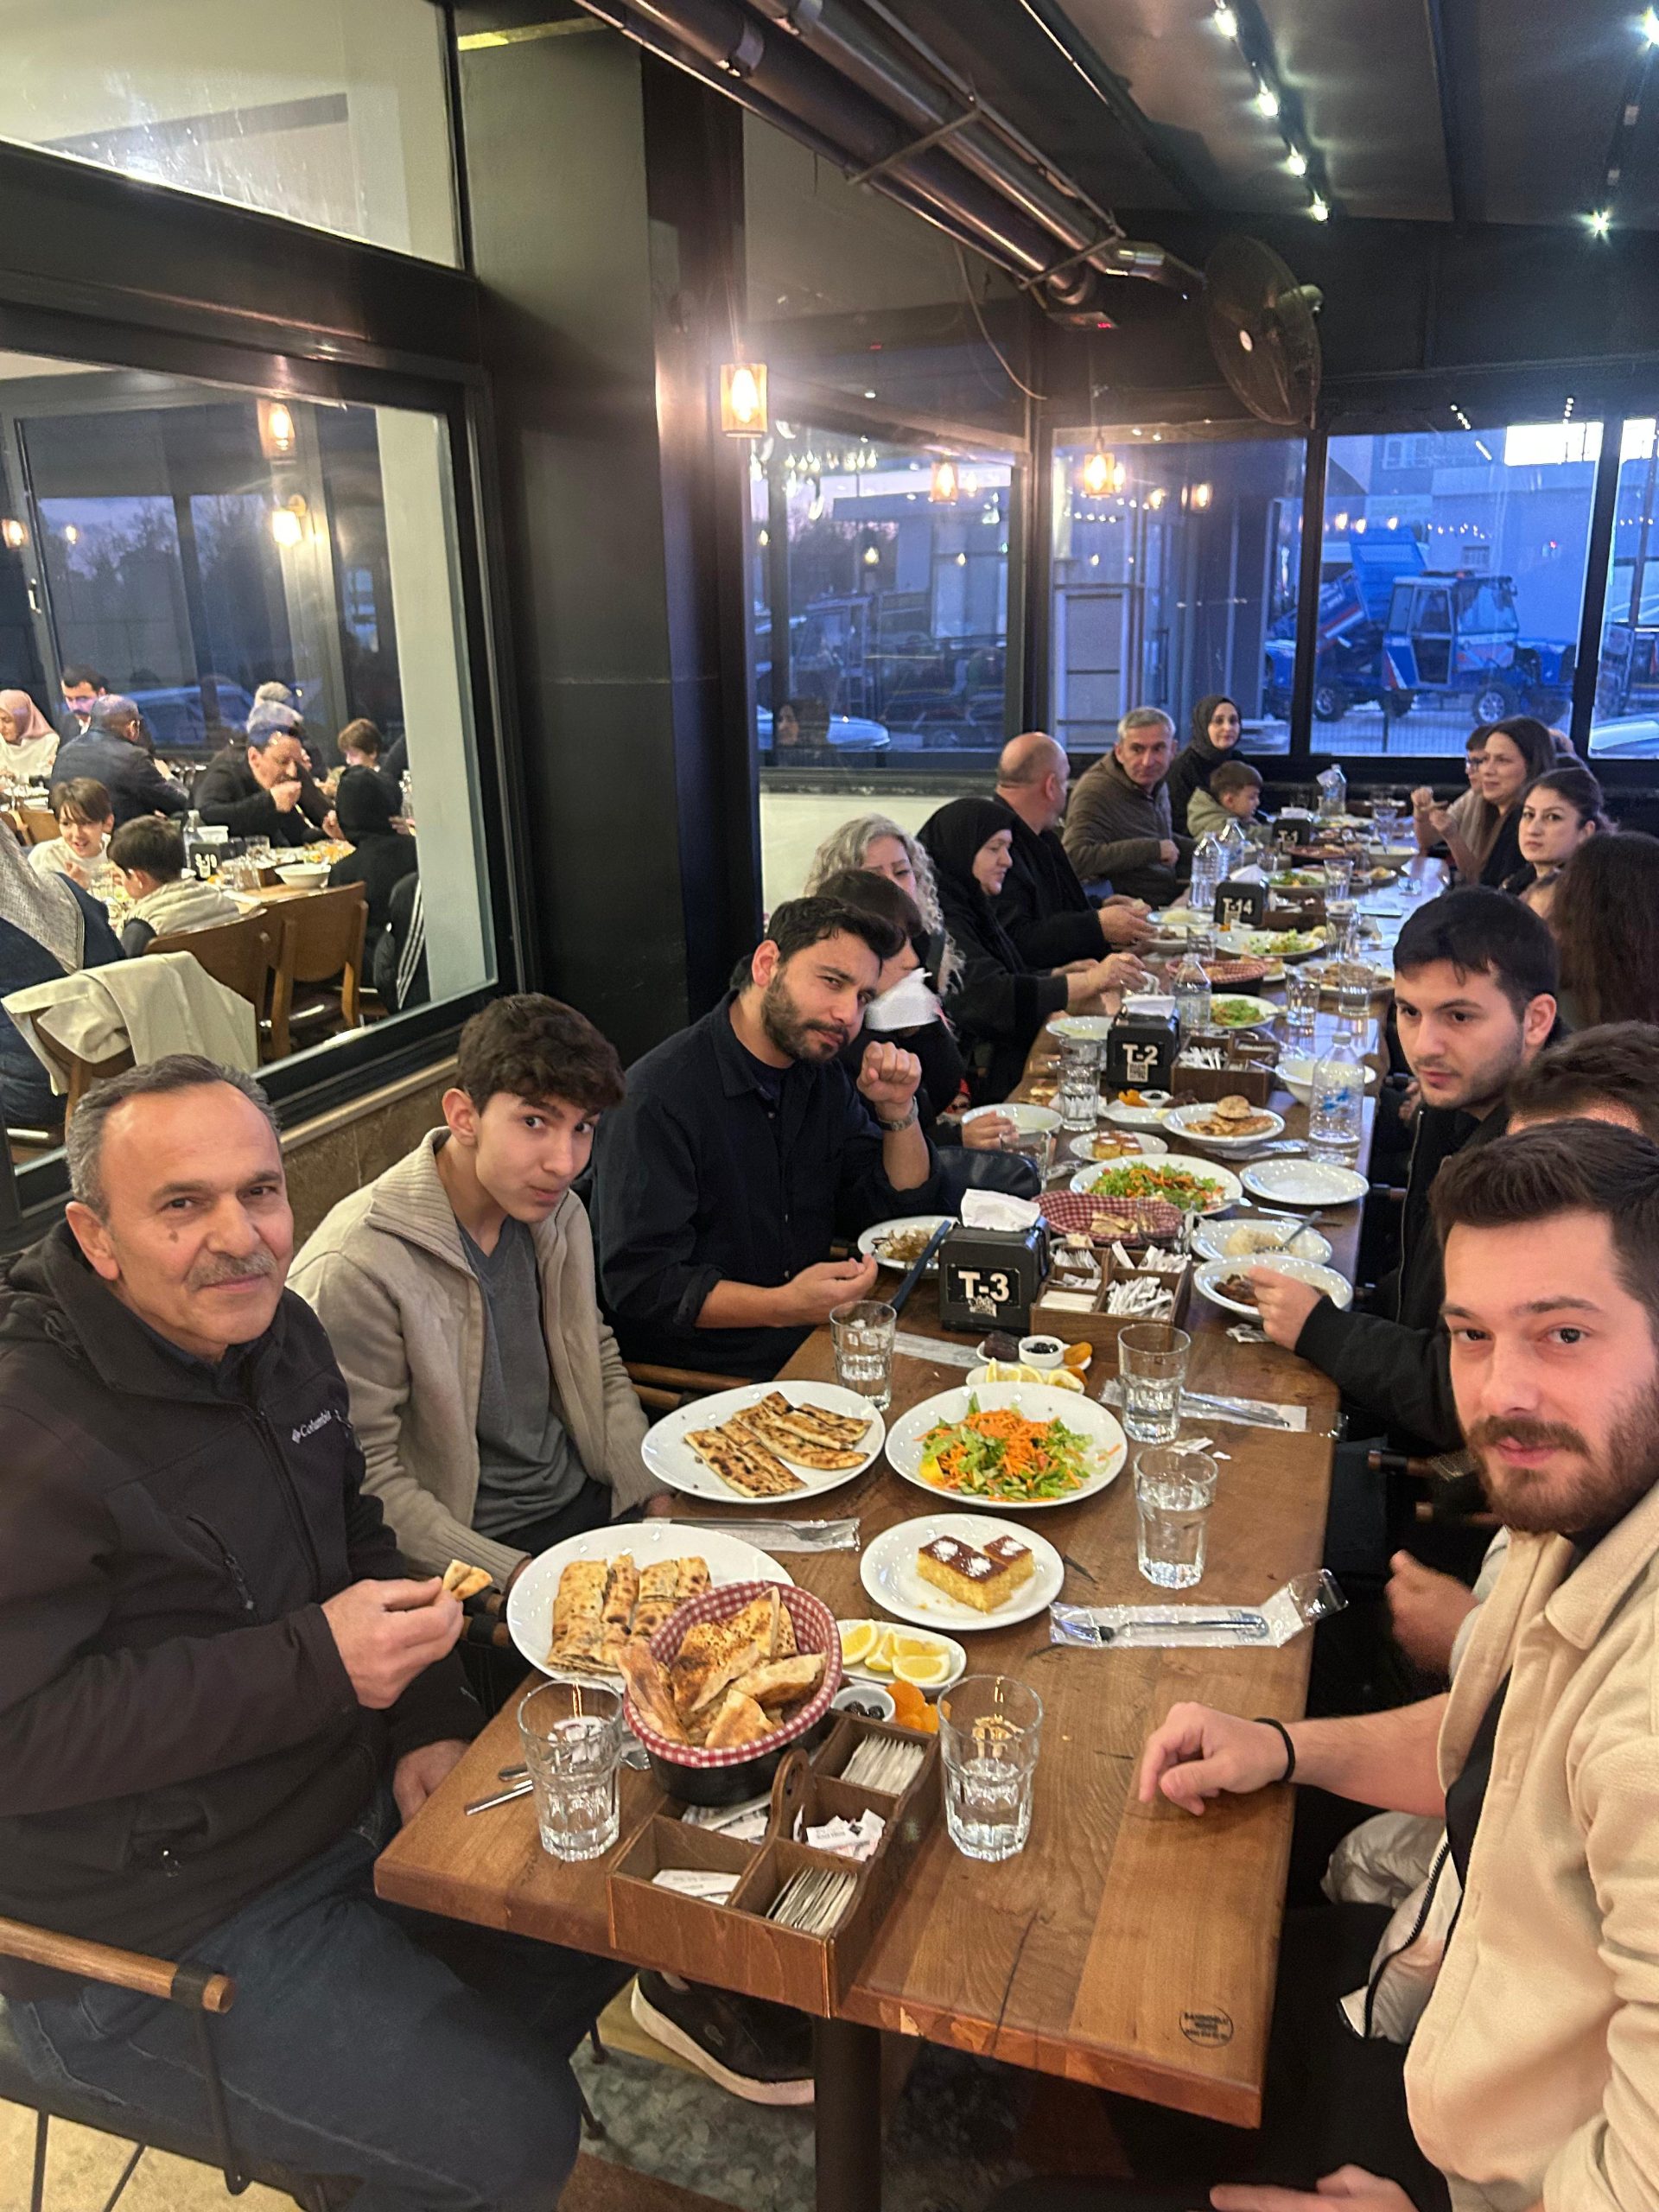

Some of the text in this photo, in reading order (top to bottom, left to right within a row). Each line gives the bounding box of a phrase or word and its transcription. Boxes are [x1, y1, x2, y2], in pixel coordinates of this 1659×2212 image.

[1222, 898, 1252, 915] T-14
[1122, 1043, 1159, 1065] T-2
[958, 1270, 1010, 1302] T-3
